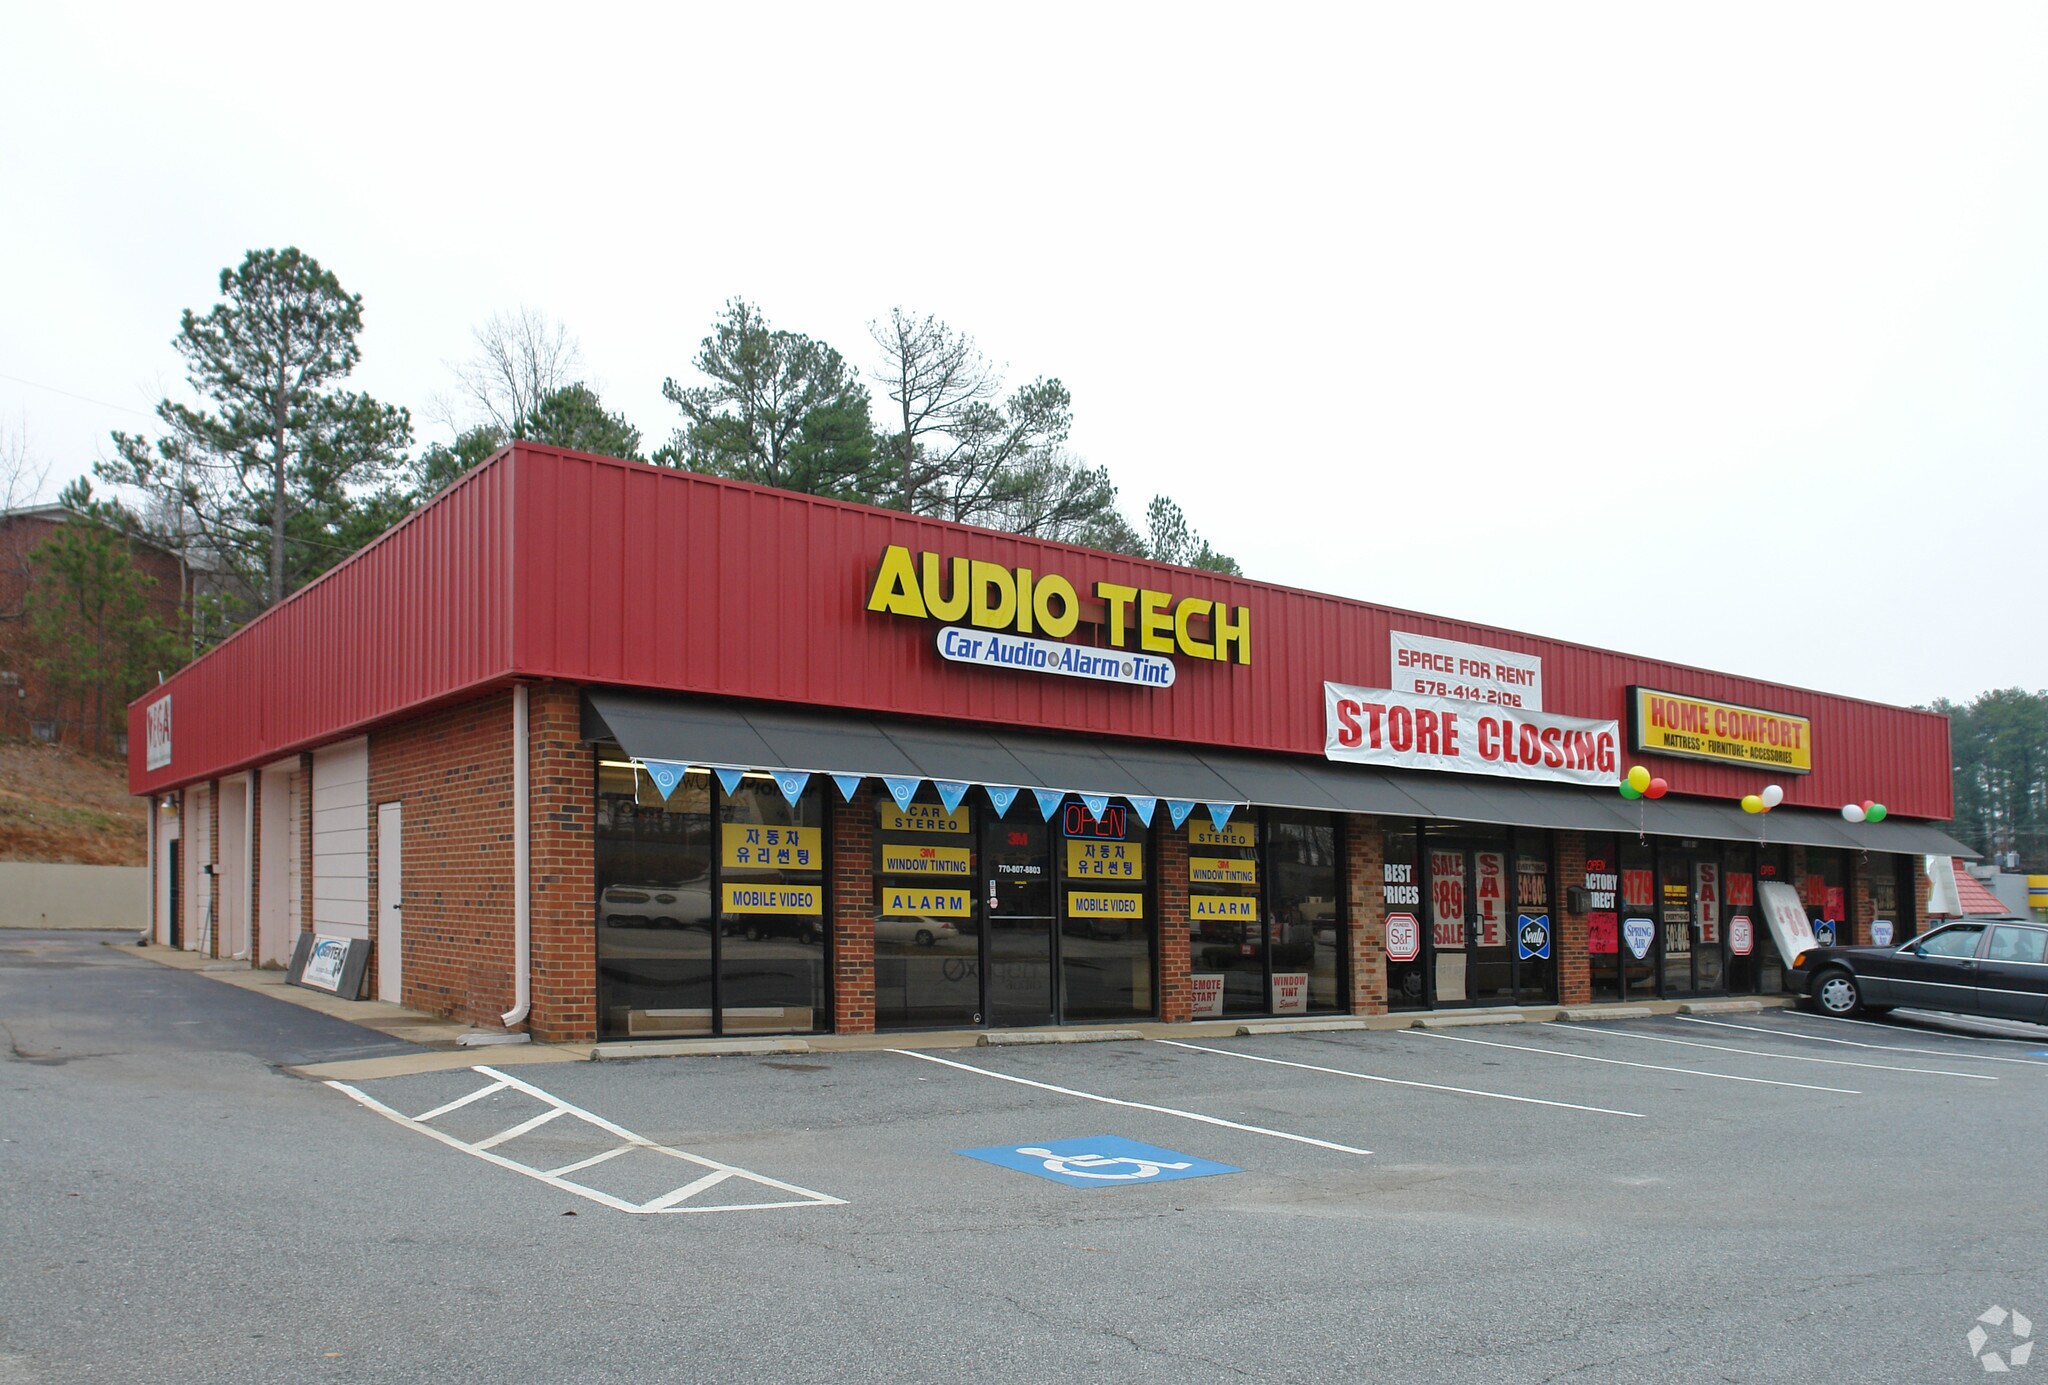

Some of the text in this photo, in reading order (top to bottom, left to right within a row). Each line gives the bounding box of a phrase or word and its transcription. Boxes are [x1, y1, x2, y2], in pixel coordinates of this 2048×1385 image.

[867, 544, 1251, 665] AUDIO TECH
[944, 631, 1170, 684] Car Audio Alarm Tint
[1398, 648, 1535, 687] SPACE FOR RENT
[1414, 679, 1522, 707] 678-414-2108
[1651, 697, 1802, 749] HOME COMFORT
[1336, 698, 1615, 773] STORE CLOSING
[1663, 732, 1792, 764] MATTRESS FURNITURE ACCESSORIES
[909, 806, 940, 818] CAR
[895, 817, 957, 831] STEREO
[1209, 823, 1233, 834] CR
[746, 829, 799, 847] 자동차
[1007, 832, 1028, 846] 3M
[1198, 833, 1246, 845] STEREO
[920, 848, 935, 858] 3M
[1085, 844, 1125, 859] 자동차
[887, 858, 967, 873] WINDOW TINTING
[1217, 860, 1230, 869] 3M
[1432, 853, 1462, 876] SALE
[1586, 859, 1606, 871] OPEN
[1192, 868, 1253, 882] WINDOW TINTING
[1384, 863, 1412, 883] BEST
[1585, 872, 1618, 891] ACTORY
[733, 890, 813, 907] MOBILE VIDEO
[892, 895, 962, 910] ALARM
[1076, 898, 1136, 912] MOBILE VIDEO
[1433, 879, 1462, 920] $89
[1478, 854, 1499, 944] SALE
[1590, 891, 1616, 909] IRECT
[1700, 864, 1715, 942] SALE
[1197, 901, 1250, 915] ALARM
[1391, 928, 1412, 945] S&F
[1434, 923, 1463, 945] SALE
[1522, 928, 1545, 947] Sealy
[1626, 924, 1651, 938] SPRING
[1634, 938, 1646, 949] AIR
[1191, 979, 1221, 990] EMOTE
[1273, 975, 1306, 987] WINDOW
[1191, 991, 1217, 1002] START
[1281, 987, 1298, 997] TINT
